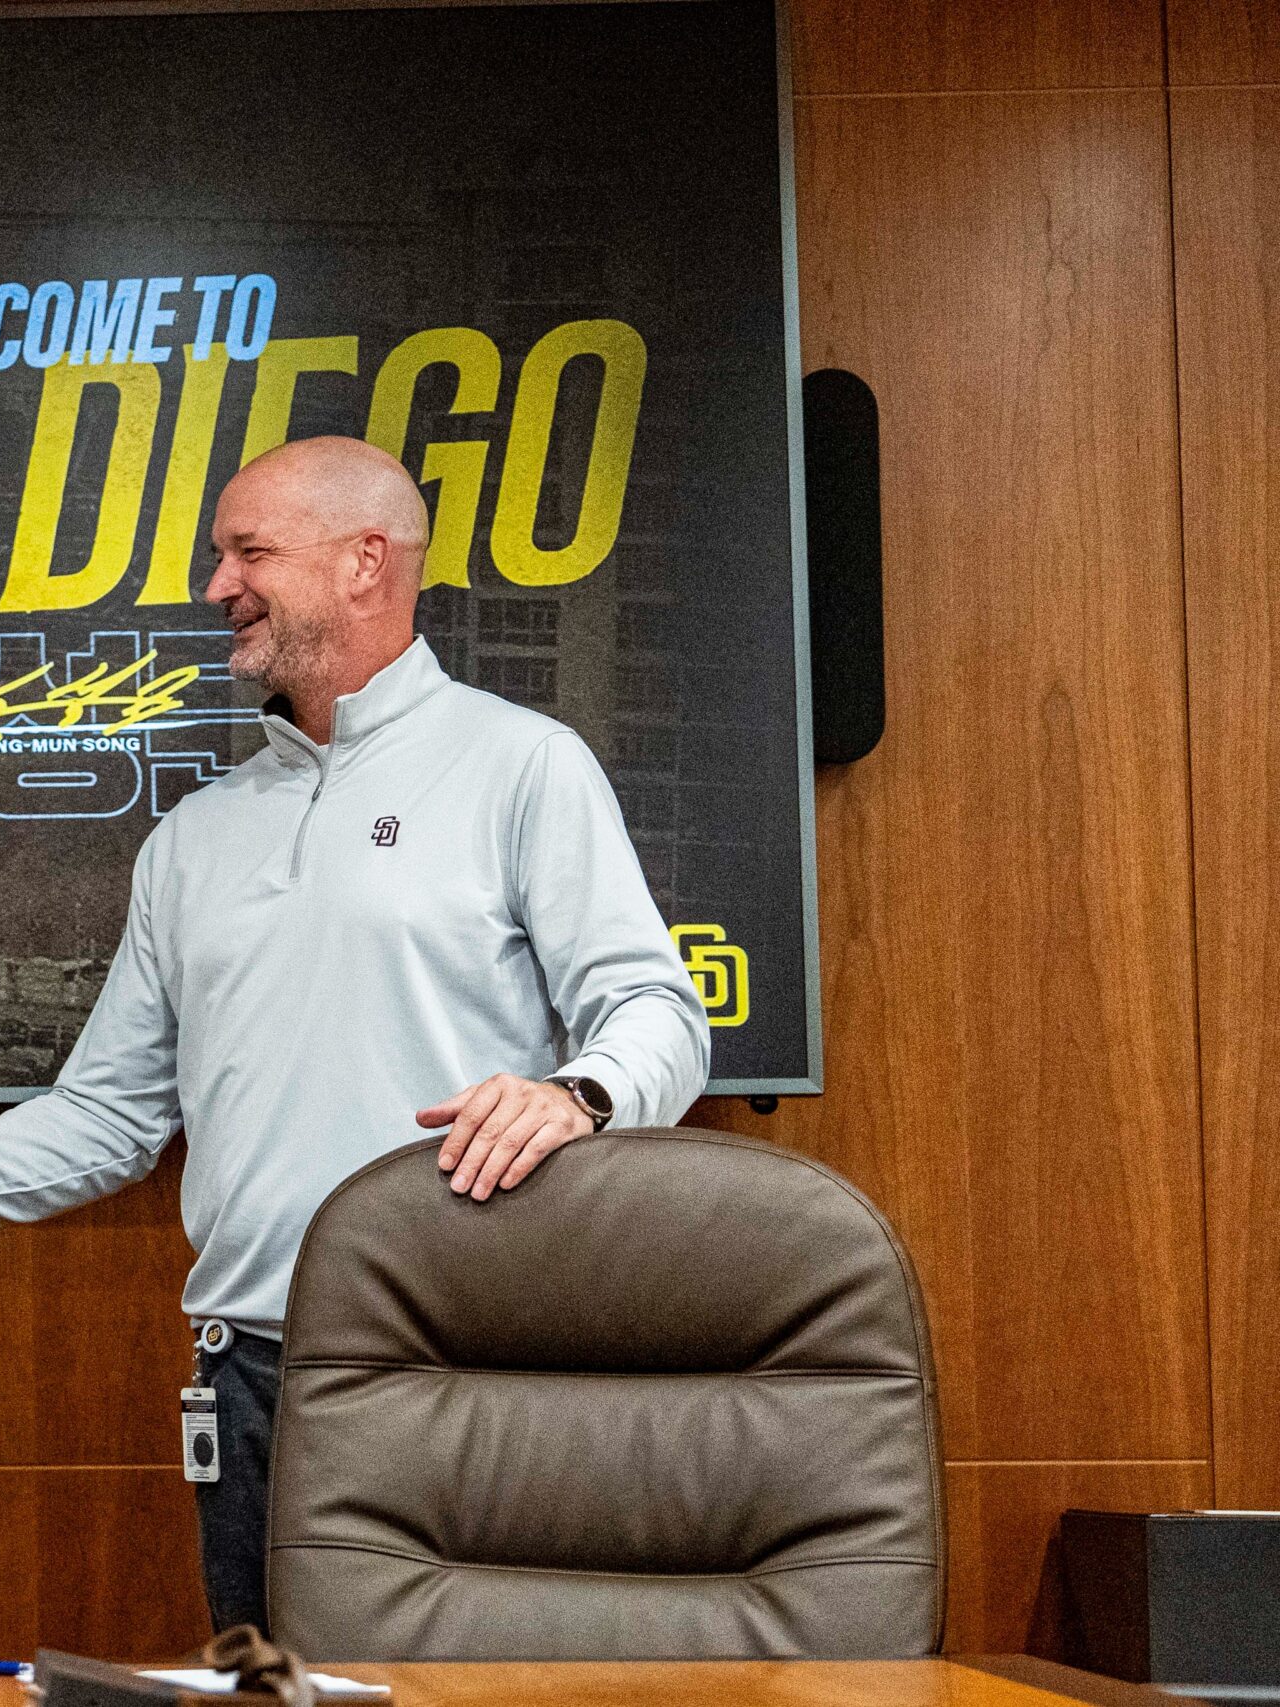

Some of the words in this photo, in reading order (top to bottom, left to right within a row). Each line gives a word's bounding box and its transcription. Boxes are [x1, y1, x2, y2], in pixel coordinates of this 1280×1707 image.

[192, 273, 278, 362] TO
[82, 737, 141, 752] SONG
[370, 815, 401, 847] SD
[668, 923, 750, 1027] SD
